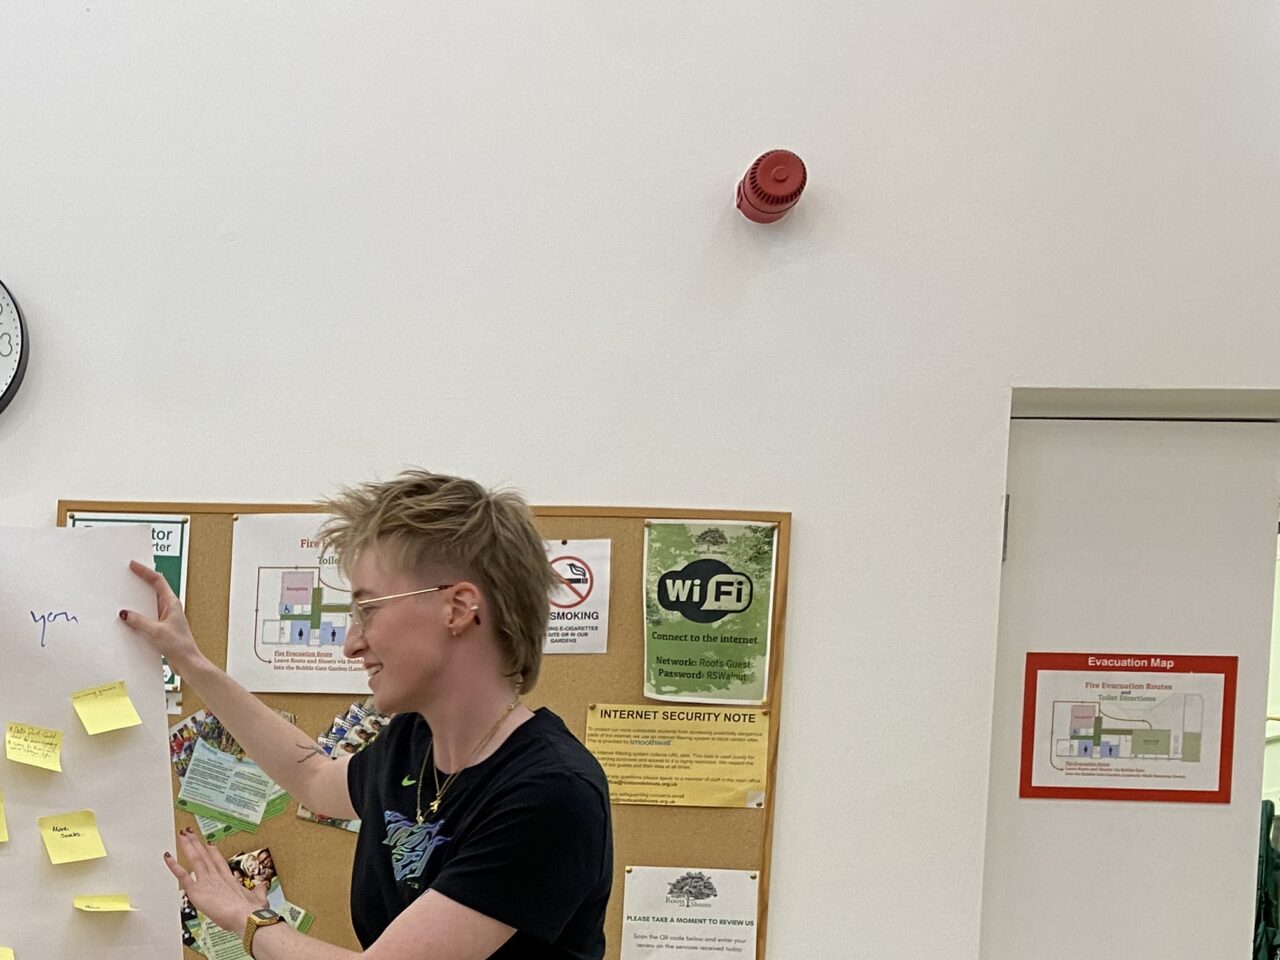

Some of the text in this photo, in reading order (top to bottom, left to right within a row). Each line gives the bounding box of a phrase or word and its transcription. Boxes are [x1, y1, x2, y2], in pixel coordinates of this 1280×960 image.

[550, 611, 599, 620] SMOKING
[30, 609, 79, 647] you
[651, 631, 688, 642] Connect
[690, 634, 700, 642] to
[702, 633, 719, 643] the
[1088, 656, 1174, 669] Evacuation Map
[600, 709, 756, 723] INTERNET SECURITY NOTE
[676, 917, 707, 925] MOMENT
